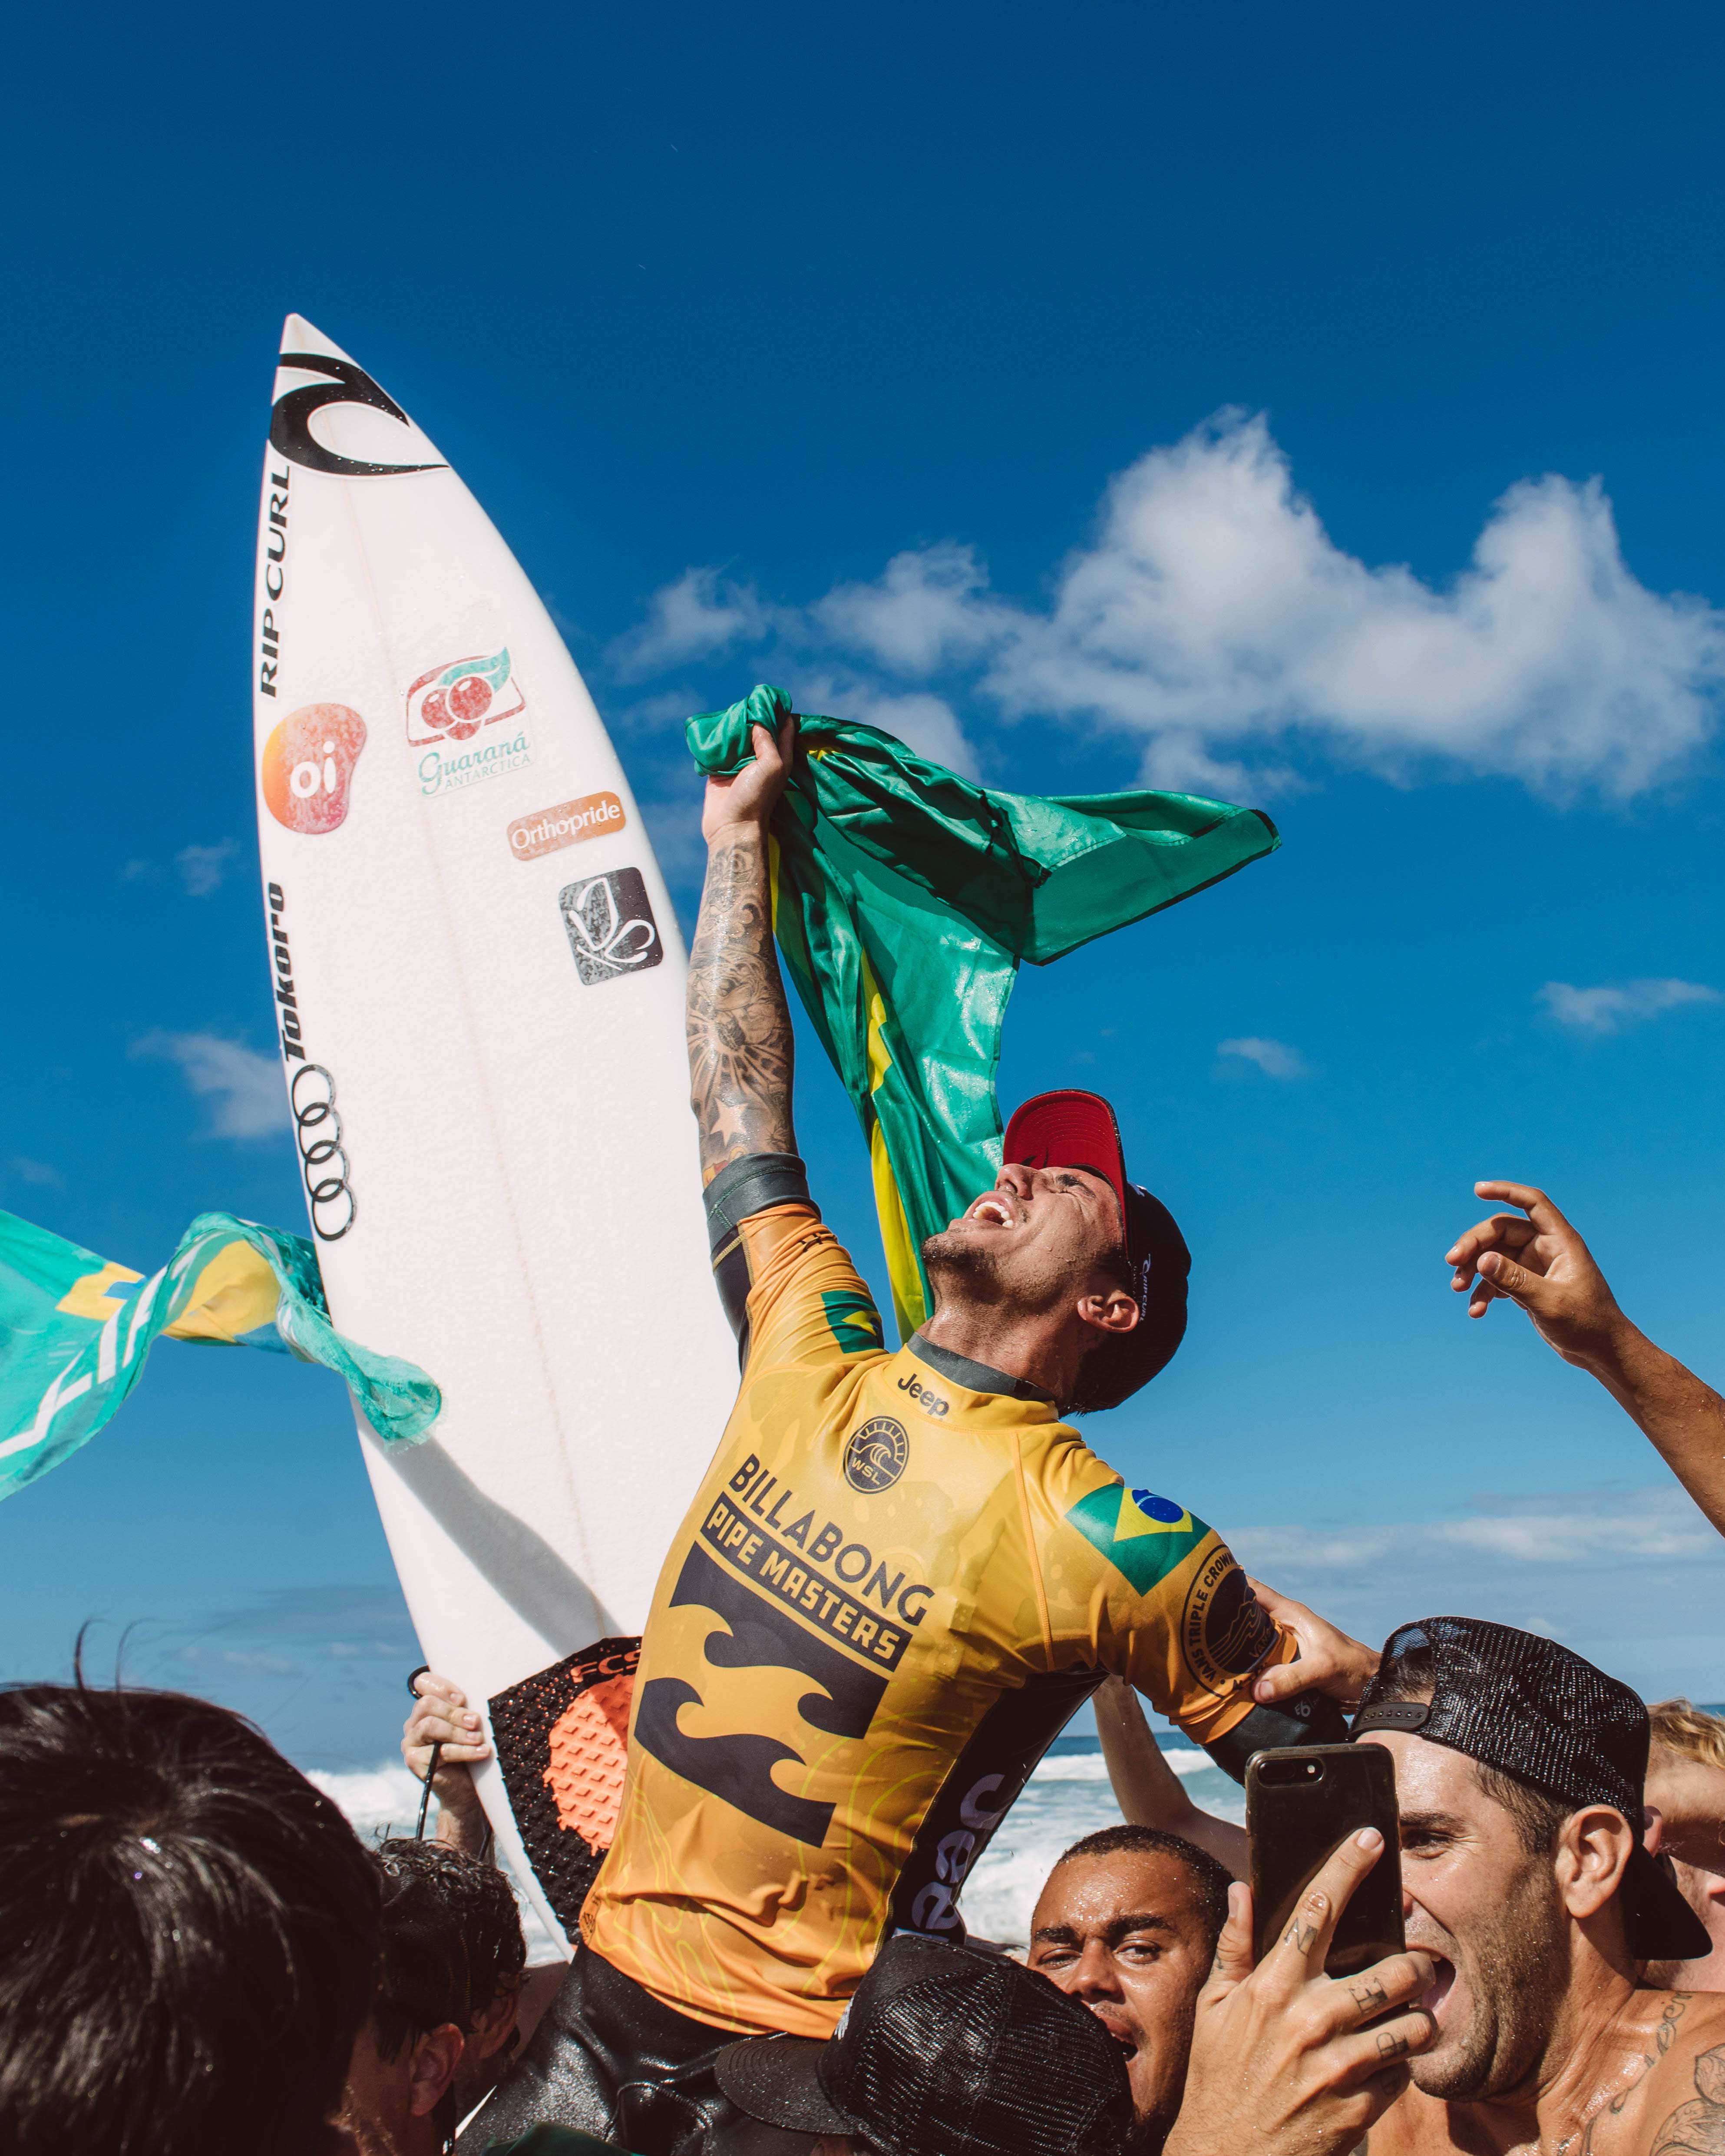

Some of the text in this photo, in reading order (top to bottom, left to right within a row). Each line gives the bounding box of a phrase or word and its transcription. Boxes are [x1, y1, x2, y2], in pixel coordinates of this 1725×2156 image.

[261, 465, 290, 698] RIP CURL
[290, 741, 337, 798] oi
[418, 731, 529, 795] Guaraná
[444, 754, 530, 790] ANTARCTICA
[512, 800, 621, 850] Orthopride
[268, 882, 306, 1061] Tokoro
[898, 1373, 949, 1416] Jeep
[852, 1457, 881, 1485] WSL
[729, 1453, 935, 1626] BILLABONG
[707, 1503, 900, 1661] PIPE MASTERS
[1188, 1589, 1209, 1647] TRIPLE
[1192, 1648, 1216, 1682] VANS
[891, 1773, 1005, 1943] Jee
